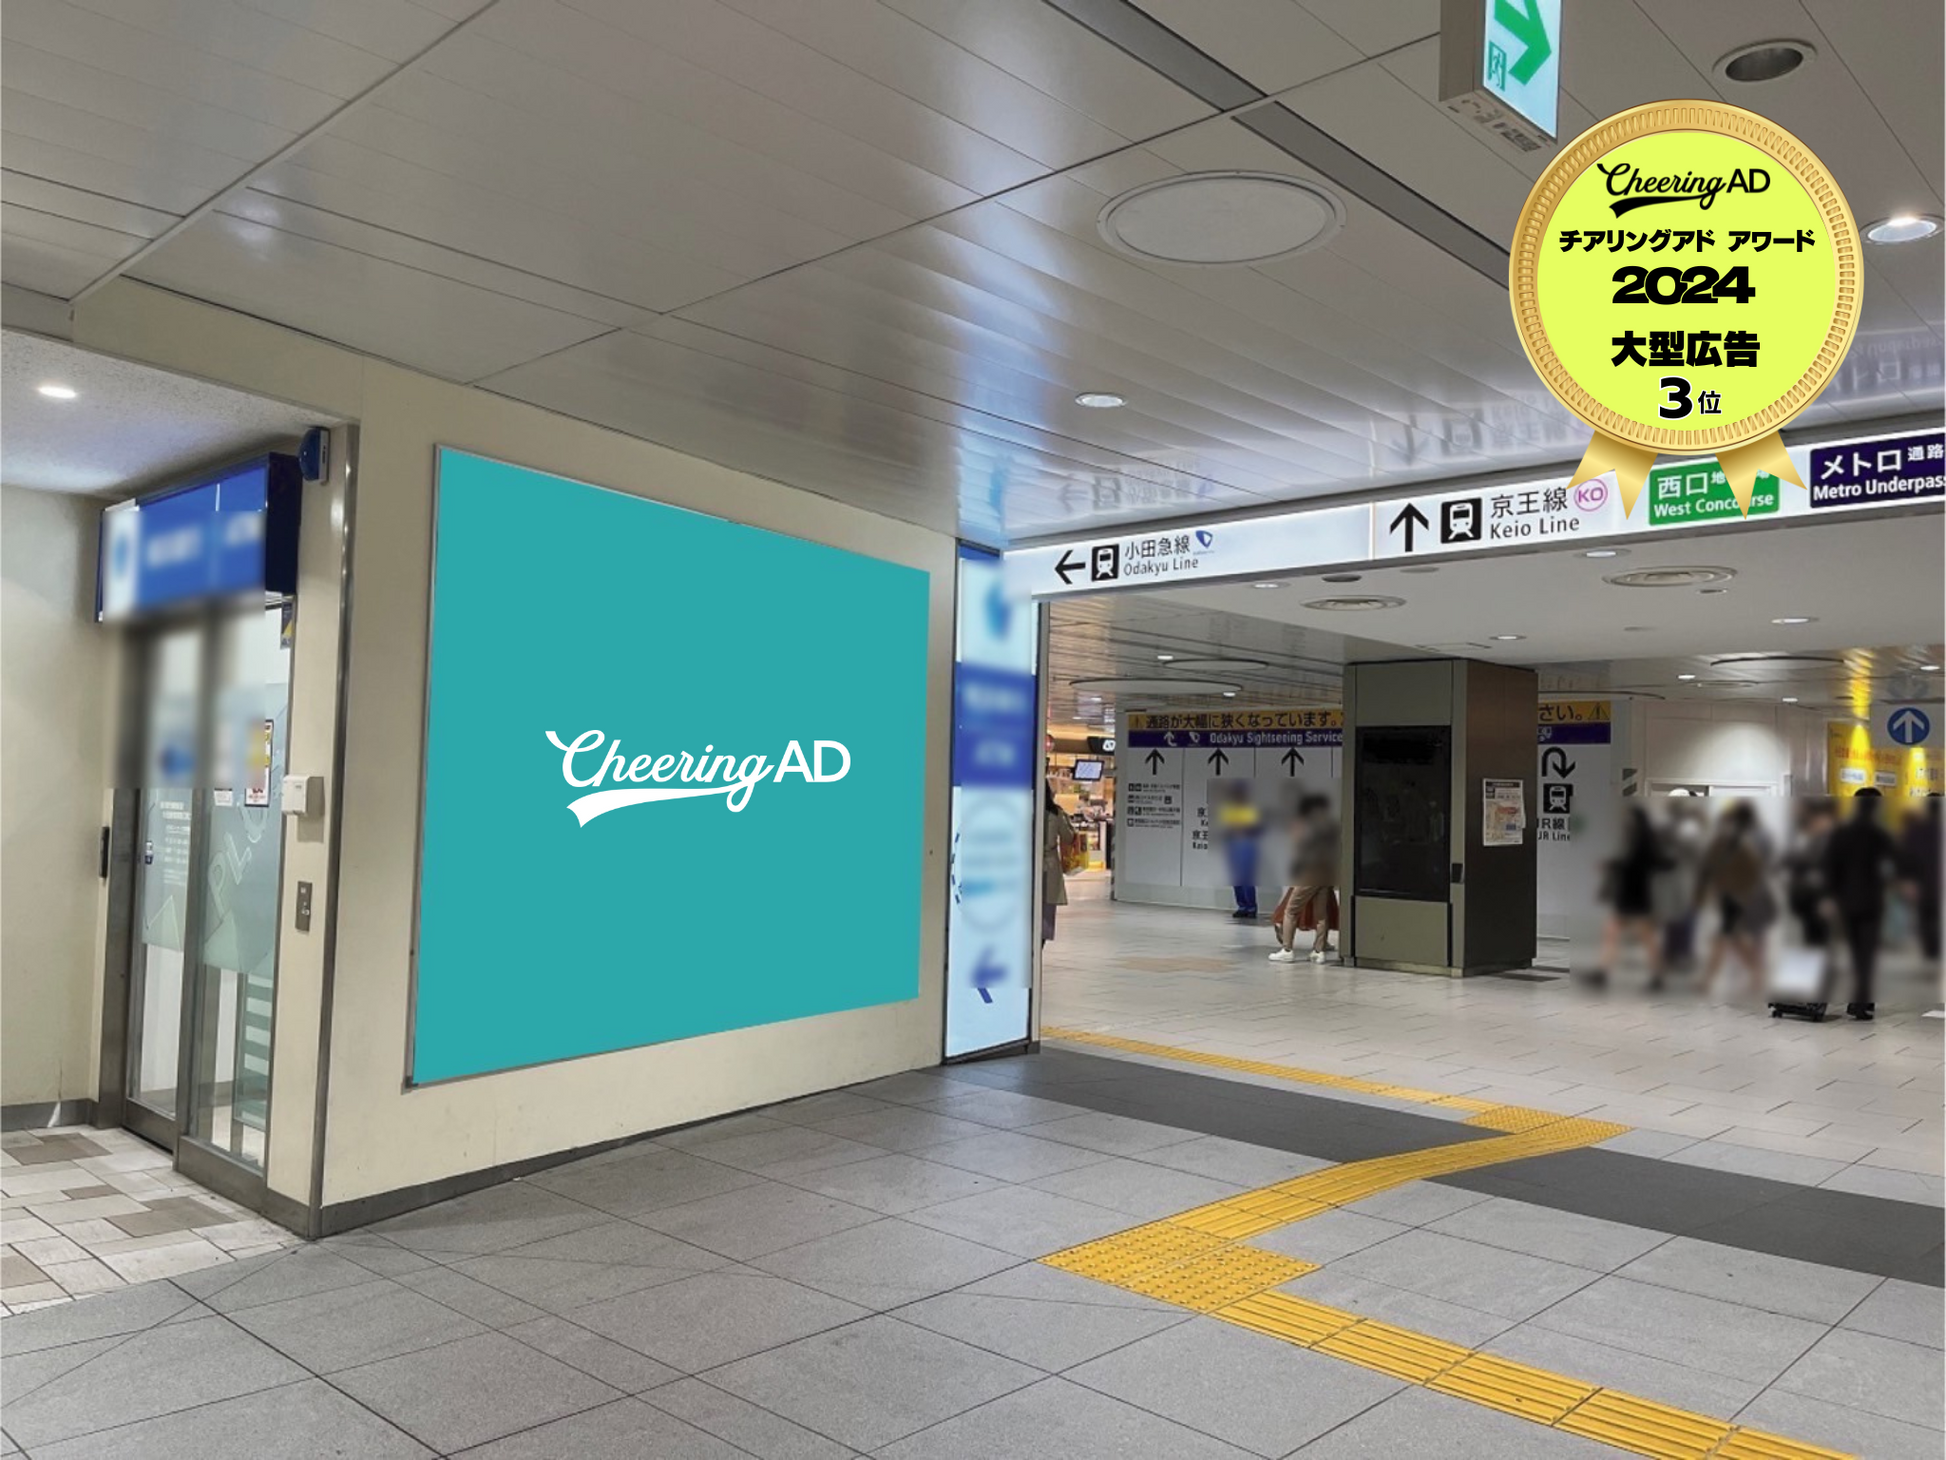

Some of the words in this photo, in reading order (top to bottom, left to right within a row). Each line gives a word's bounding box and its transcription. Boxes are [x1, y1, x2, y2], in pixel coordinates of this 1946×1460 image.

[1490, 486, 1568, 519] 京王線
[1813, 484, 1862, 501] Metro
[1654, 501, 1692, 518] West
[1695, 494, 1775, 514] Concorse
[1490, 523, 1531, 540] Keio
[1539, 514, 1580, 535] Line
[1124, 535, 1191, 561] 小田急線
[1123, 560, 1169, 577] Odakyu
[1172, 557, 1199, 571] Line
[1146, 709, 1343, 729] 通路が大幅に狭くなっています。
[1209, 732, 1244, 746] Odakyu
[1246, 731, 1304, 746] Sightseeing
[545, 729, 775, 815] Cheering
[773, 740, 851, 783] AD
